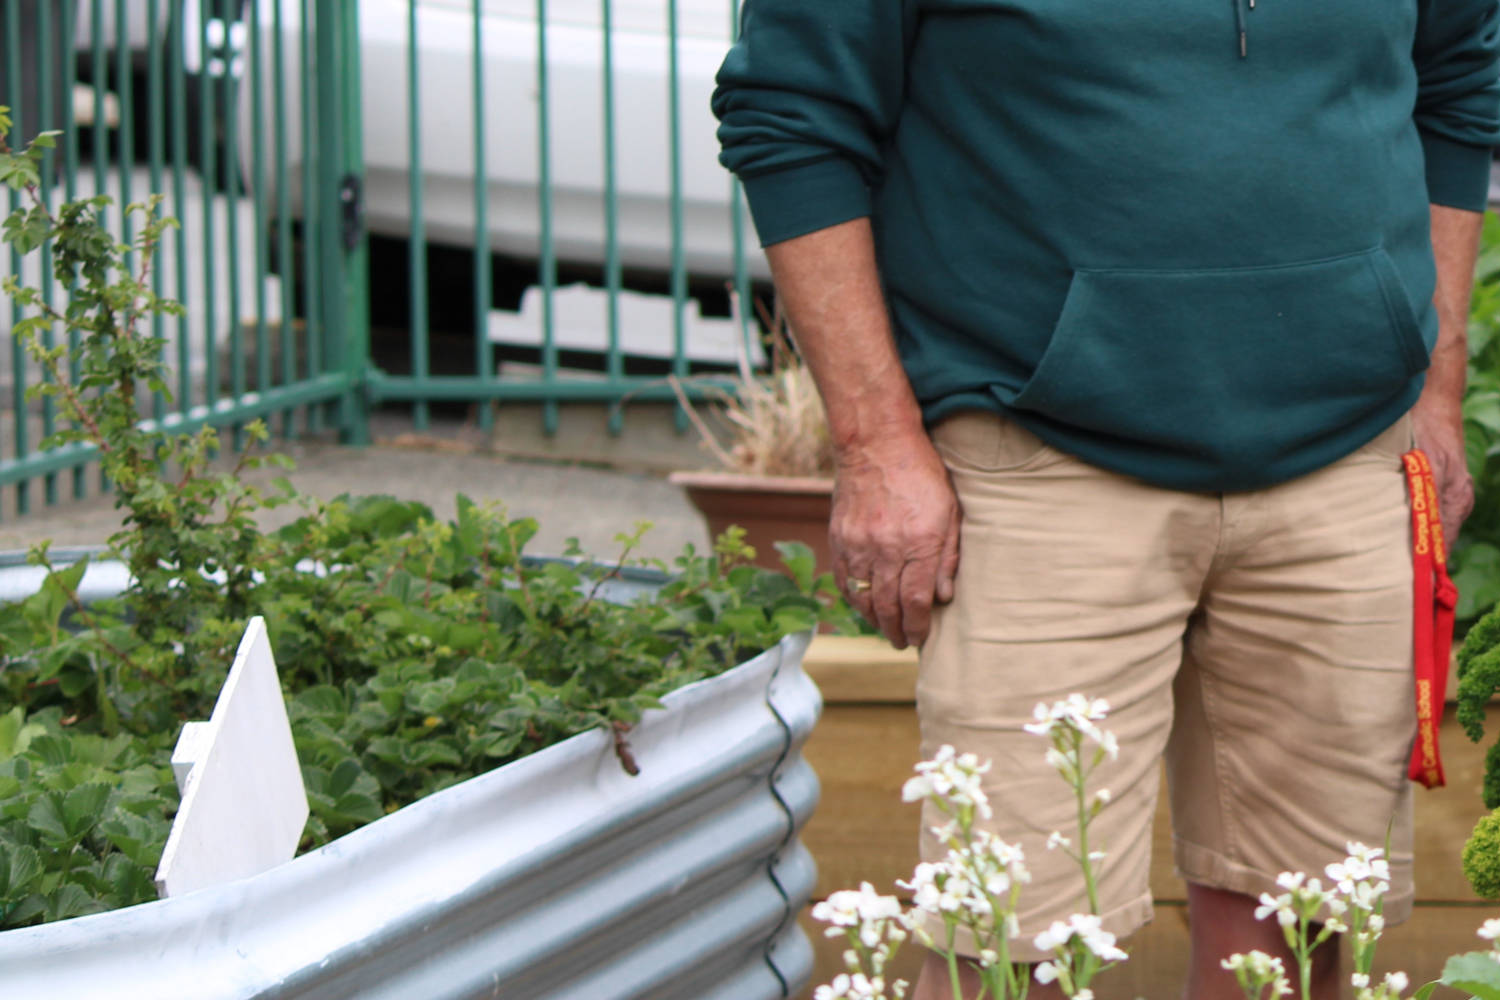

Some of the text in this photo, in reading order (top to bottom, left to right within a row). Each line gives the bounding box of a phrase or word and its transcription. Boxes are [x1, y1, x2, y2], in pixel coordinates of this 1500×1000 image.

[1412, 475, 1426, 511] Christi
[1415, 513, 1429, 554] Corpus
[1418, 679, 1431, 719] School
